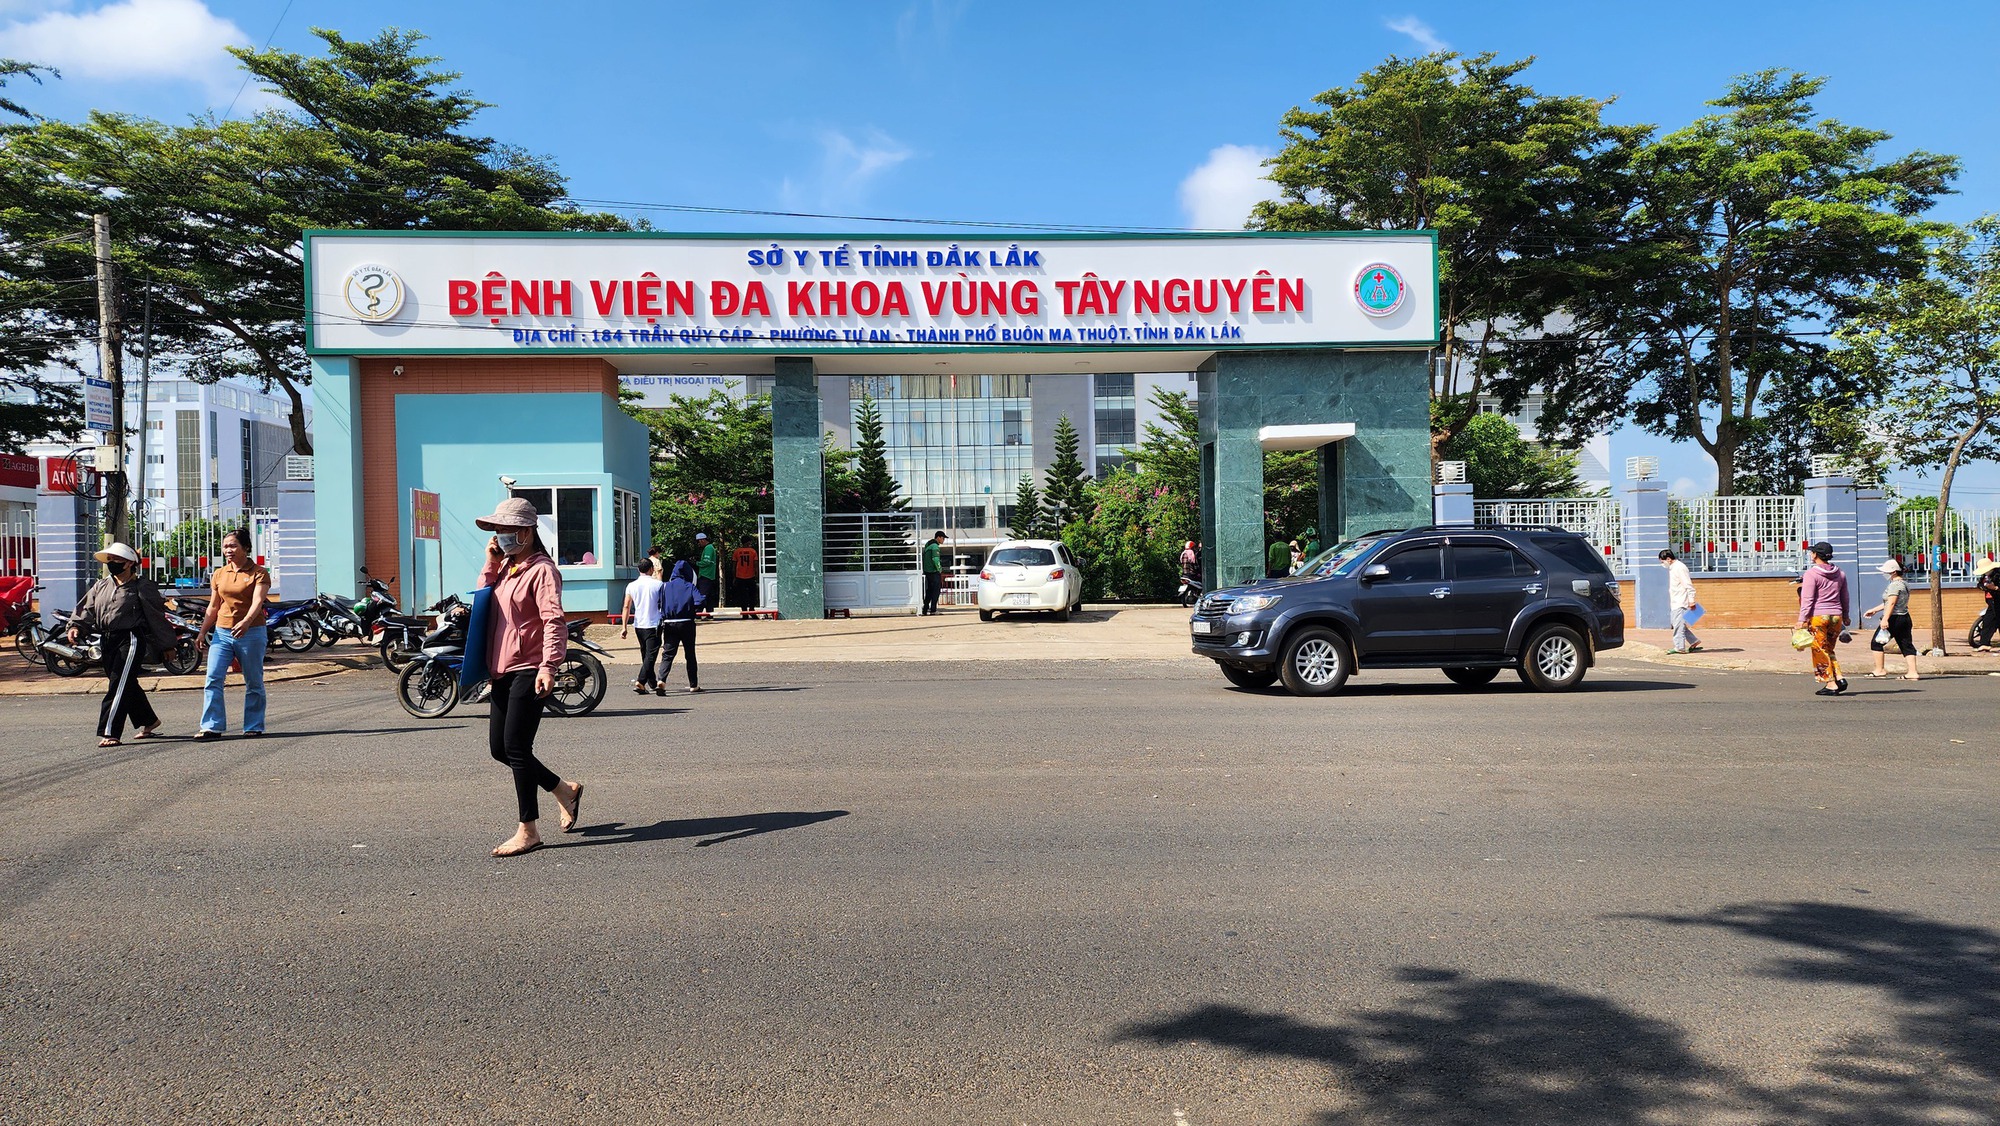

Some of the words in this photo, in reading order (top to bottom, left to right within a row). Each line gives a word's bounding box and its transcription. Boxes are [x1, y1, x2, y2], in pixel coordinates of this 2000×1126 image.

[747, 243, 784, 267] SỞ
[793, 250, 809, 267] Y
[819, 243, 850, 267] TẾ
[859, 244, 918, 267] TỈNH
[926, 243, 981, 267] ĐẮK
[989, 243, 1040, 267] LẮK
[448, 271, 572, 324] BỆNH
[589, 271, 694, 324] VIỆN
[709, 280, 771, 316] ĐA
[787, 280, 910, 316] KHOA
[920, 272, 1038, 316] VÙNG
[1055, 272, 1126, 315] TÂY
[1134, 270, 1304, 314] NGUYÊN
[513, 329, 541, 346] ĐỊA
[547, 324, 576, 342] CHỈ
[592, 329, 623, 342] 184
[629, 324, 674, 342] TRẦN
[769, 325, 837, 343] PHƯỜNG
[843, 328, 863, 345] TỰ
[869, 329, 890, 343] AN
[906, 325, 960, 343] THÀNH
[965, 323, 997, 343] PHỐ
[1001, 326, 1044, 342] BUÔN
[1049, 328, 1073, 342] MA
[1134, 322, 1169, 340] TỈNH
[1174, 321, 1206, 340] ĐẮK
[1211, 321, 1241, 339] LẮK
[52, 470, 75, 485] ATM
[740, 555, 750, 567] 14
